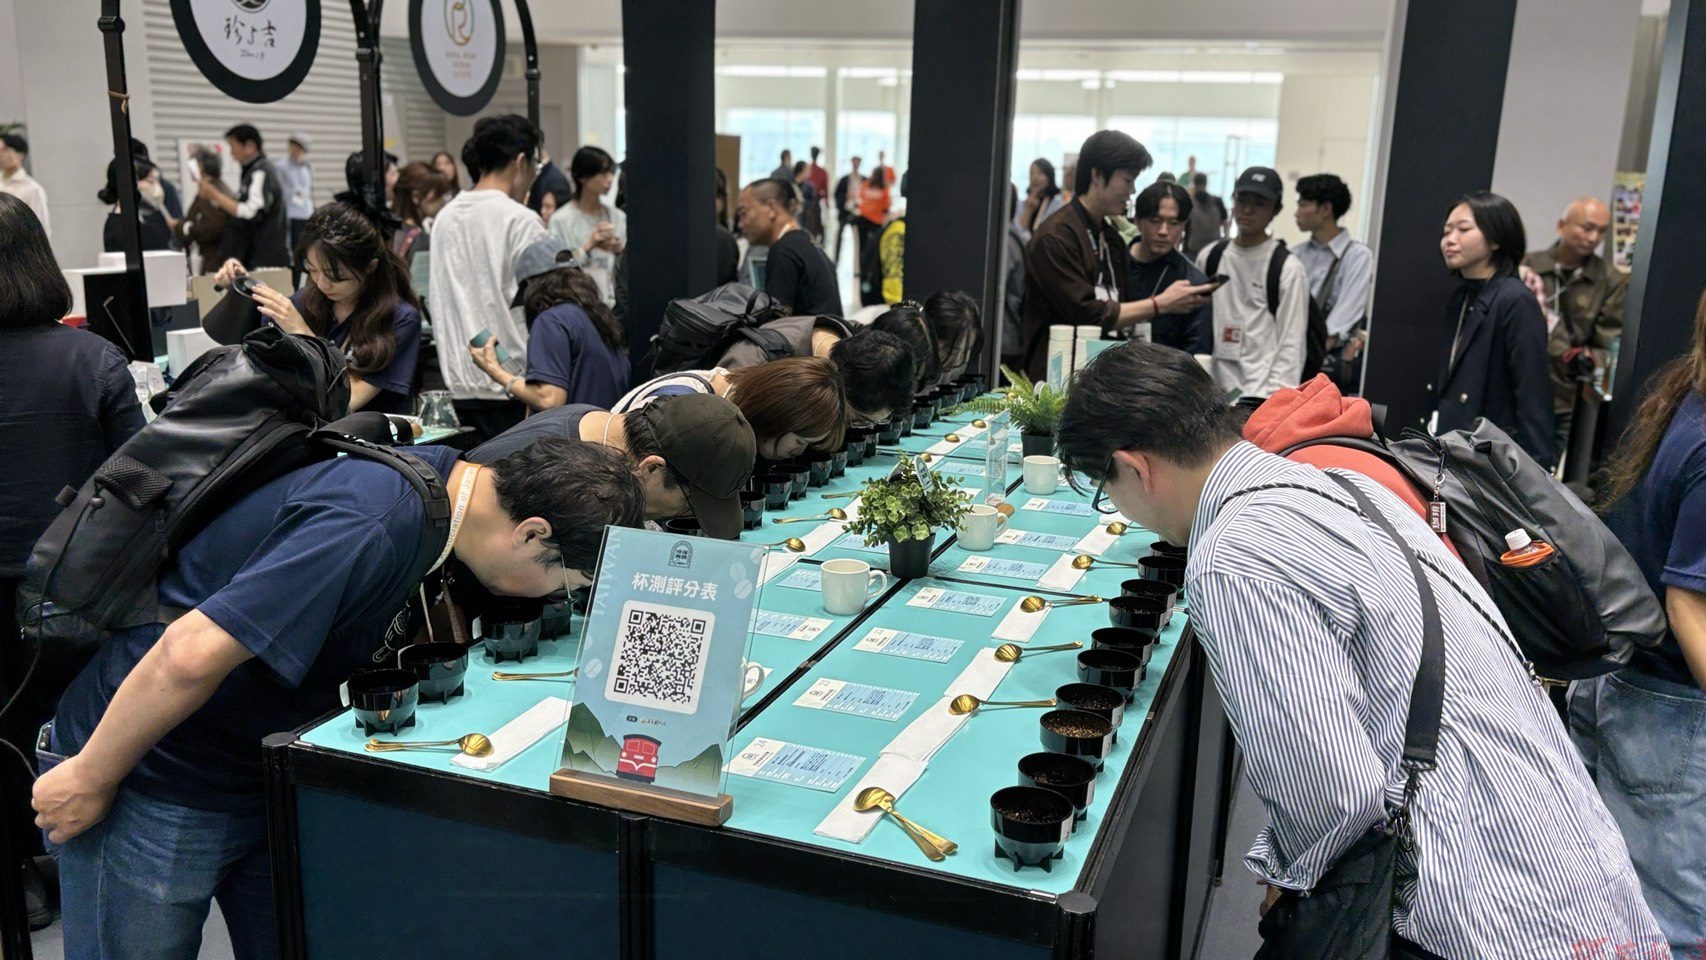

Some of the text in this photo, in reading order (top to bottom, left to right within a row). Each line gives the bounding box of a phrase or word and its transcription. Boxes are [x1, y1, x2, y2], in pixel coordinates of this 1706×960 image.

[631, 572, 718, 601] 杯測評分表
